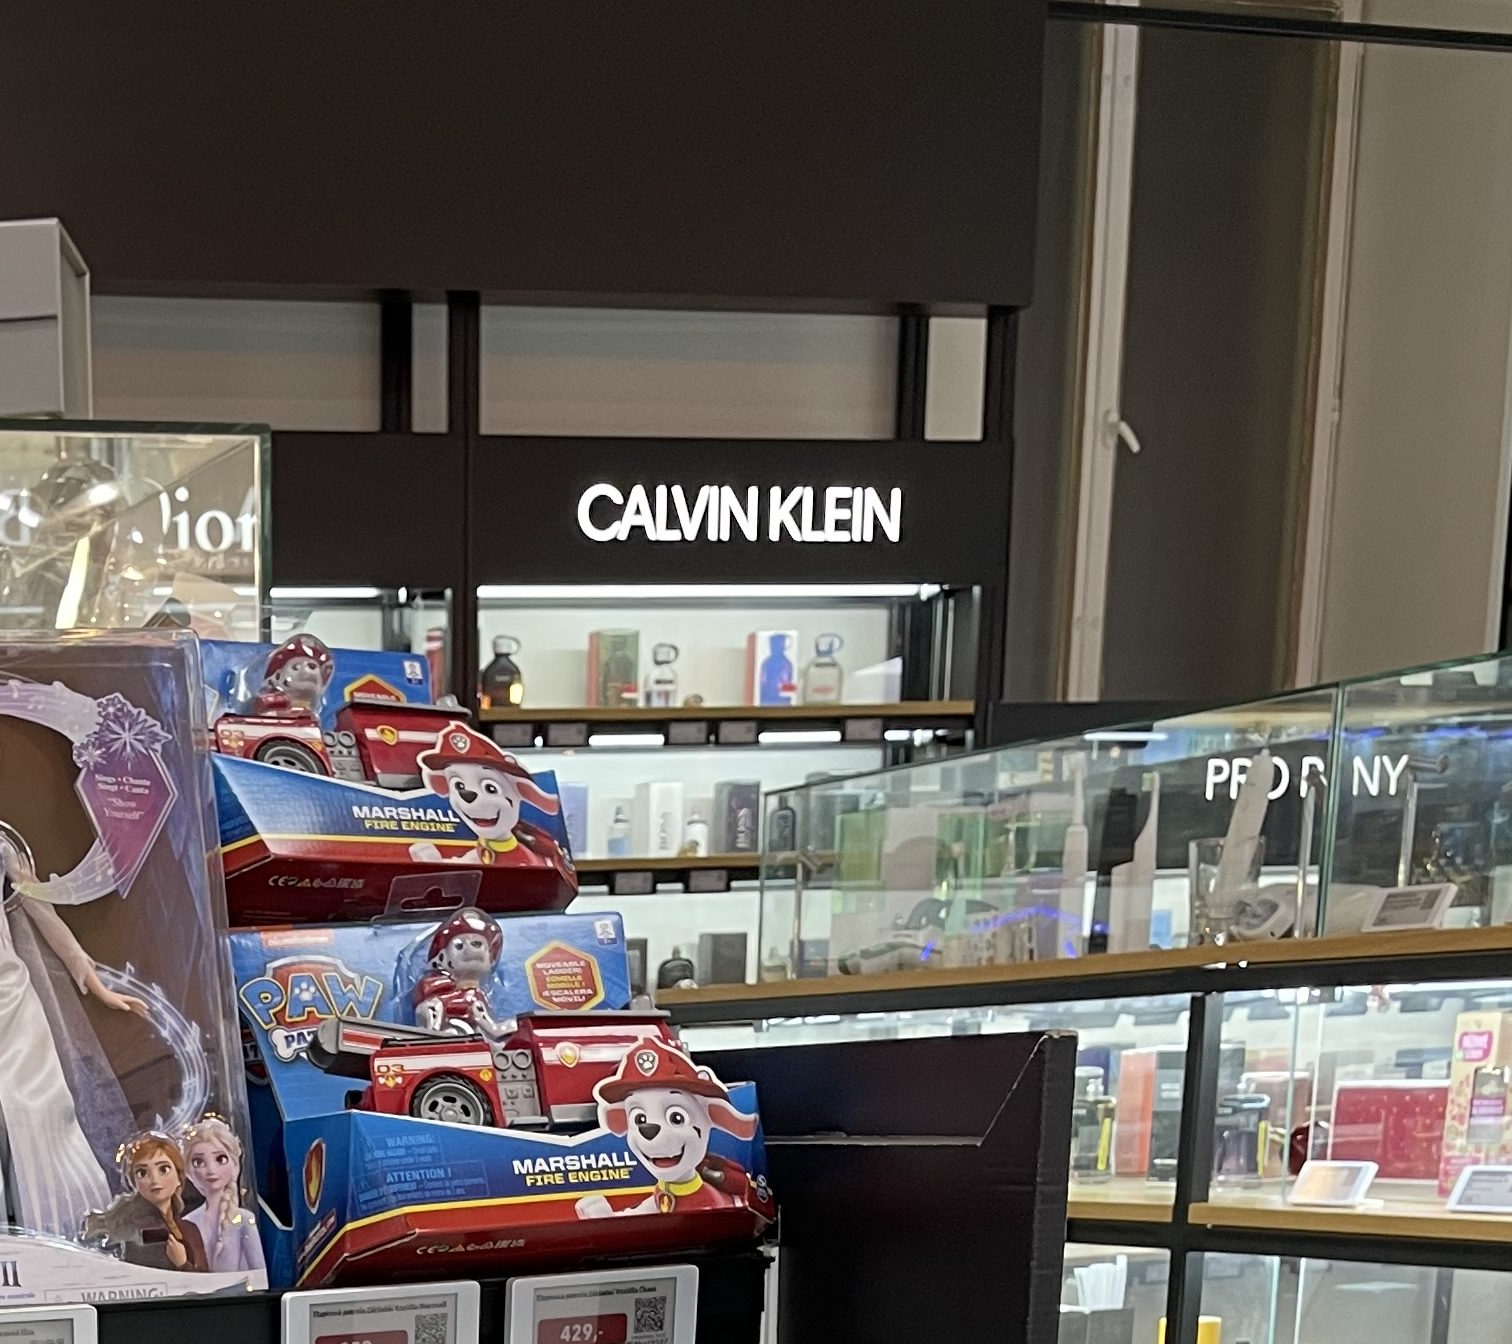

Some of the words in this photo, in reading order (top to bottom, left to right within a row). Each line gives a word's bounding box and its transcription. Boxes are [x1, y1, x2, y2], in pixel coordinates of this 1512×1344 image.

[578, 484, 758, 542] CALVIN
[767, 487, 902, 544] KLEIN
[352, 805, 460, 823] MARSHALL
[364, 820, 399, 831] FIRE
[239, 971, 382, 1031] PAW
[512, 1152, 638, 1175] MARSHALL
[386, 1168, 445, 1184] ATTENTION
[526, 1171, 565, 1187] FIRE
[568, 1168, 630, 1184] ENGINE
[0, 1261, 22, 1288] II
[559, 1323, 605, 1343] 429,-
